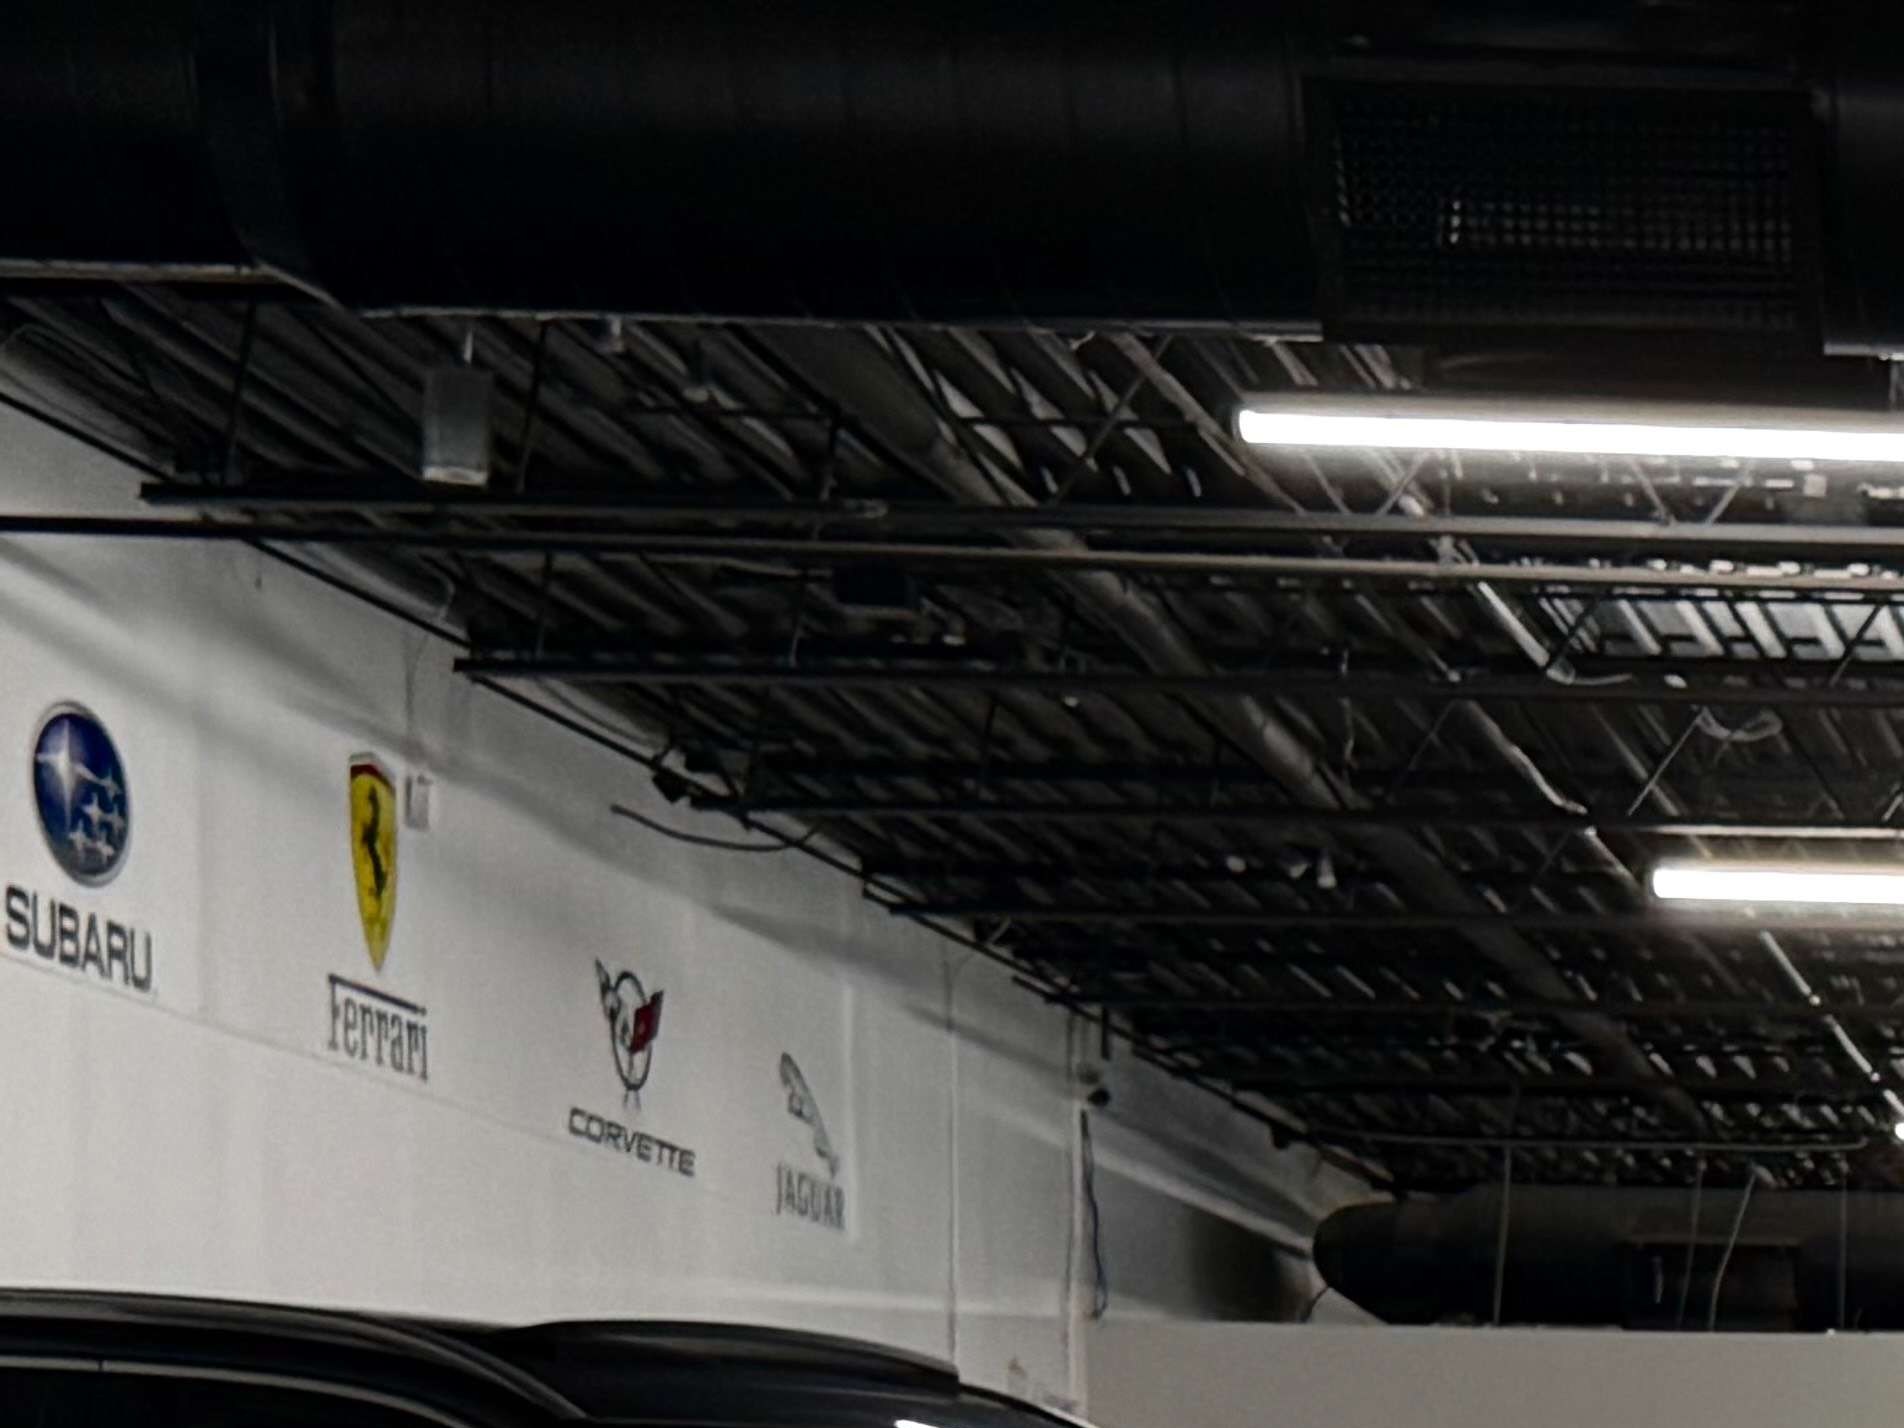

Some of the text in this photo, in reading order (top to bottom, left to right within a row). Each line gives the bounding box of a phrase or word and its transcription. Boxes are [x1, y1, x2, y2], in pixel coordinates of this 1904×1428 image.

[5, 884, 153, 992] SUBARU
[328, 973, 428, 1083] Ferrari
[568, 1107, 696, 1177] CORVETTE
